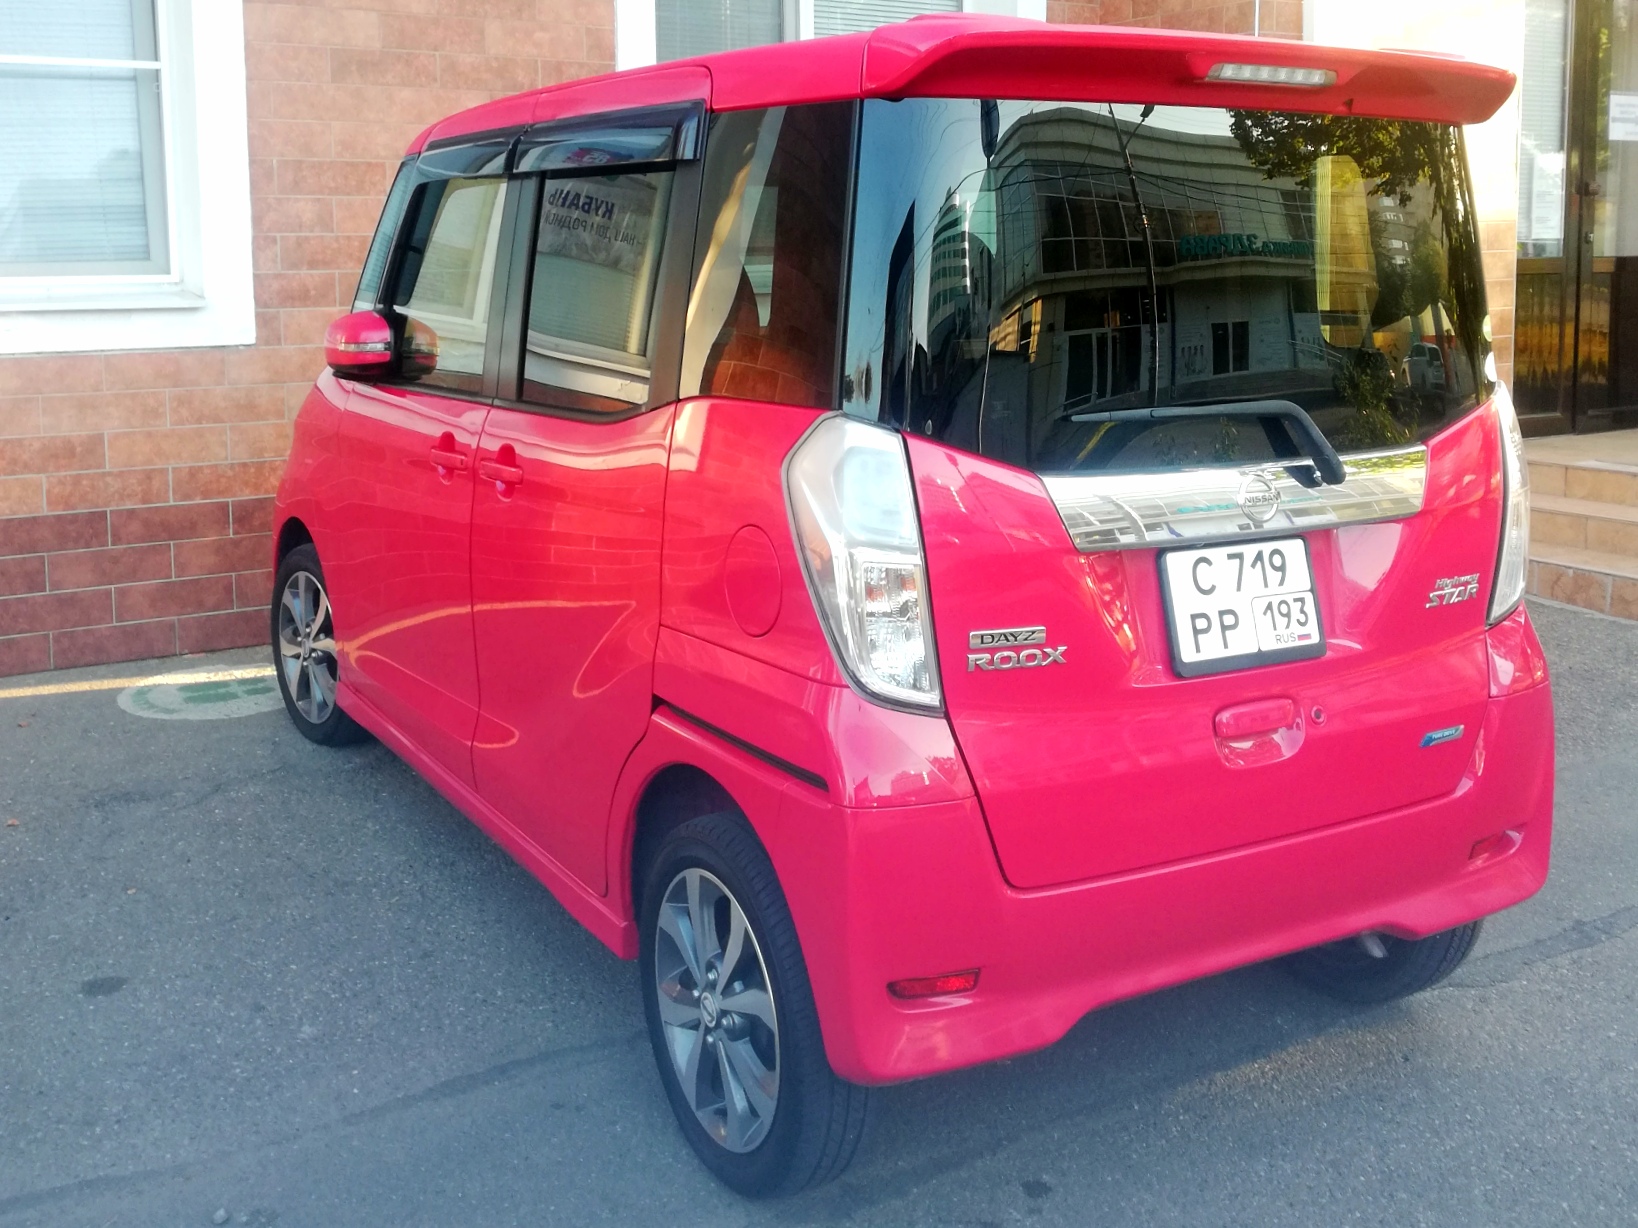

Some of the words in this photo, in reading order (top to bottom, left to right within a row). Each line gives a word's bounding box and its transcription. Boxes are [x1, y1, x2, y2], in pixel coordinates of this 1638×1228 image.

[1245, 493, 1279, 504] NISSAN
[1227, 548, 1287, 592] 719
[1425, 584, 1479, 609] STAR
[1262, 597, 1309, 631] 193
[980, 630, 1038, 645] DAYZ
[1275, 632, 1297, 644] RUS
[967, 646, 1068, 672] ROOX
